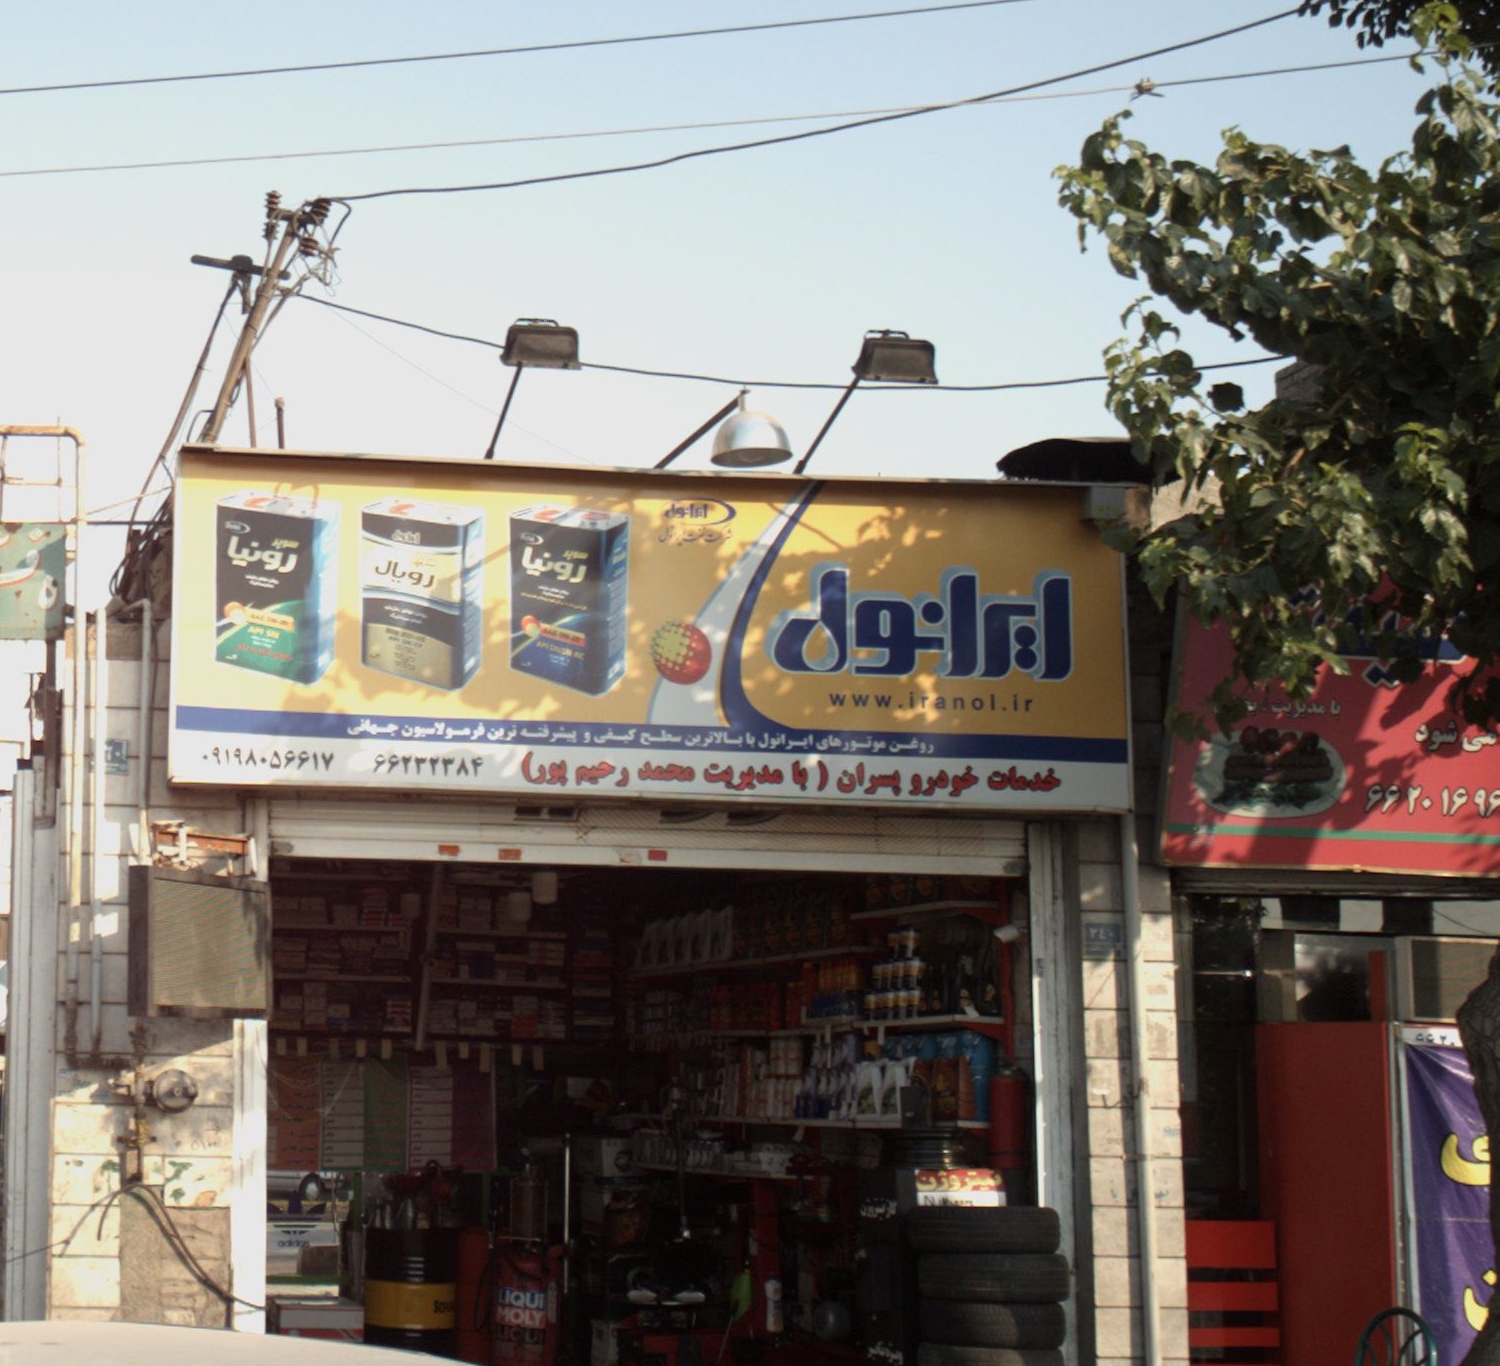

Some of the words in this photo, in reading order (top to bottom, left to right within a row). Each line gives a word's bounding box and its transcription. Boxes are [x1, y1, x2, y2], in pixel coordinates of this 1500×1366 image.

[227, 535, 298, 574] رونیا
[521, 546, 587, 583] رونیا
[375, 560, 435, 588] رویال
[768, 563, 1073, 681] ایرانول
[829, 691, 1035, 713] www.iranol.ir
[1329, 700, 1341, 719] با
[889, 737, 935, 754] روغن
[575, 760, 630, 786] رحیم
[638, 761, 695, 781] محمد
[704, 763, 784, 790] مدیریت
[792, 759, 808, 792] با
[836, 762, 901, 796] پسران
[908, 765, 979, 796] خودرو
[987, 765, 1062, 792] خدمات
